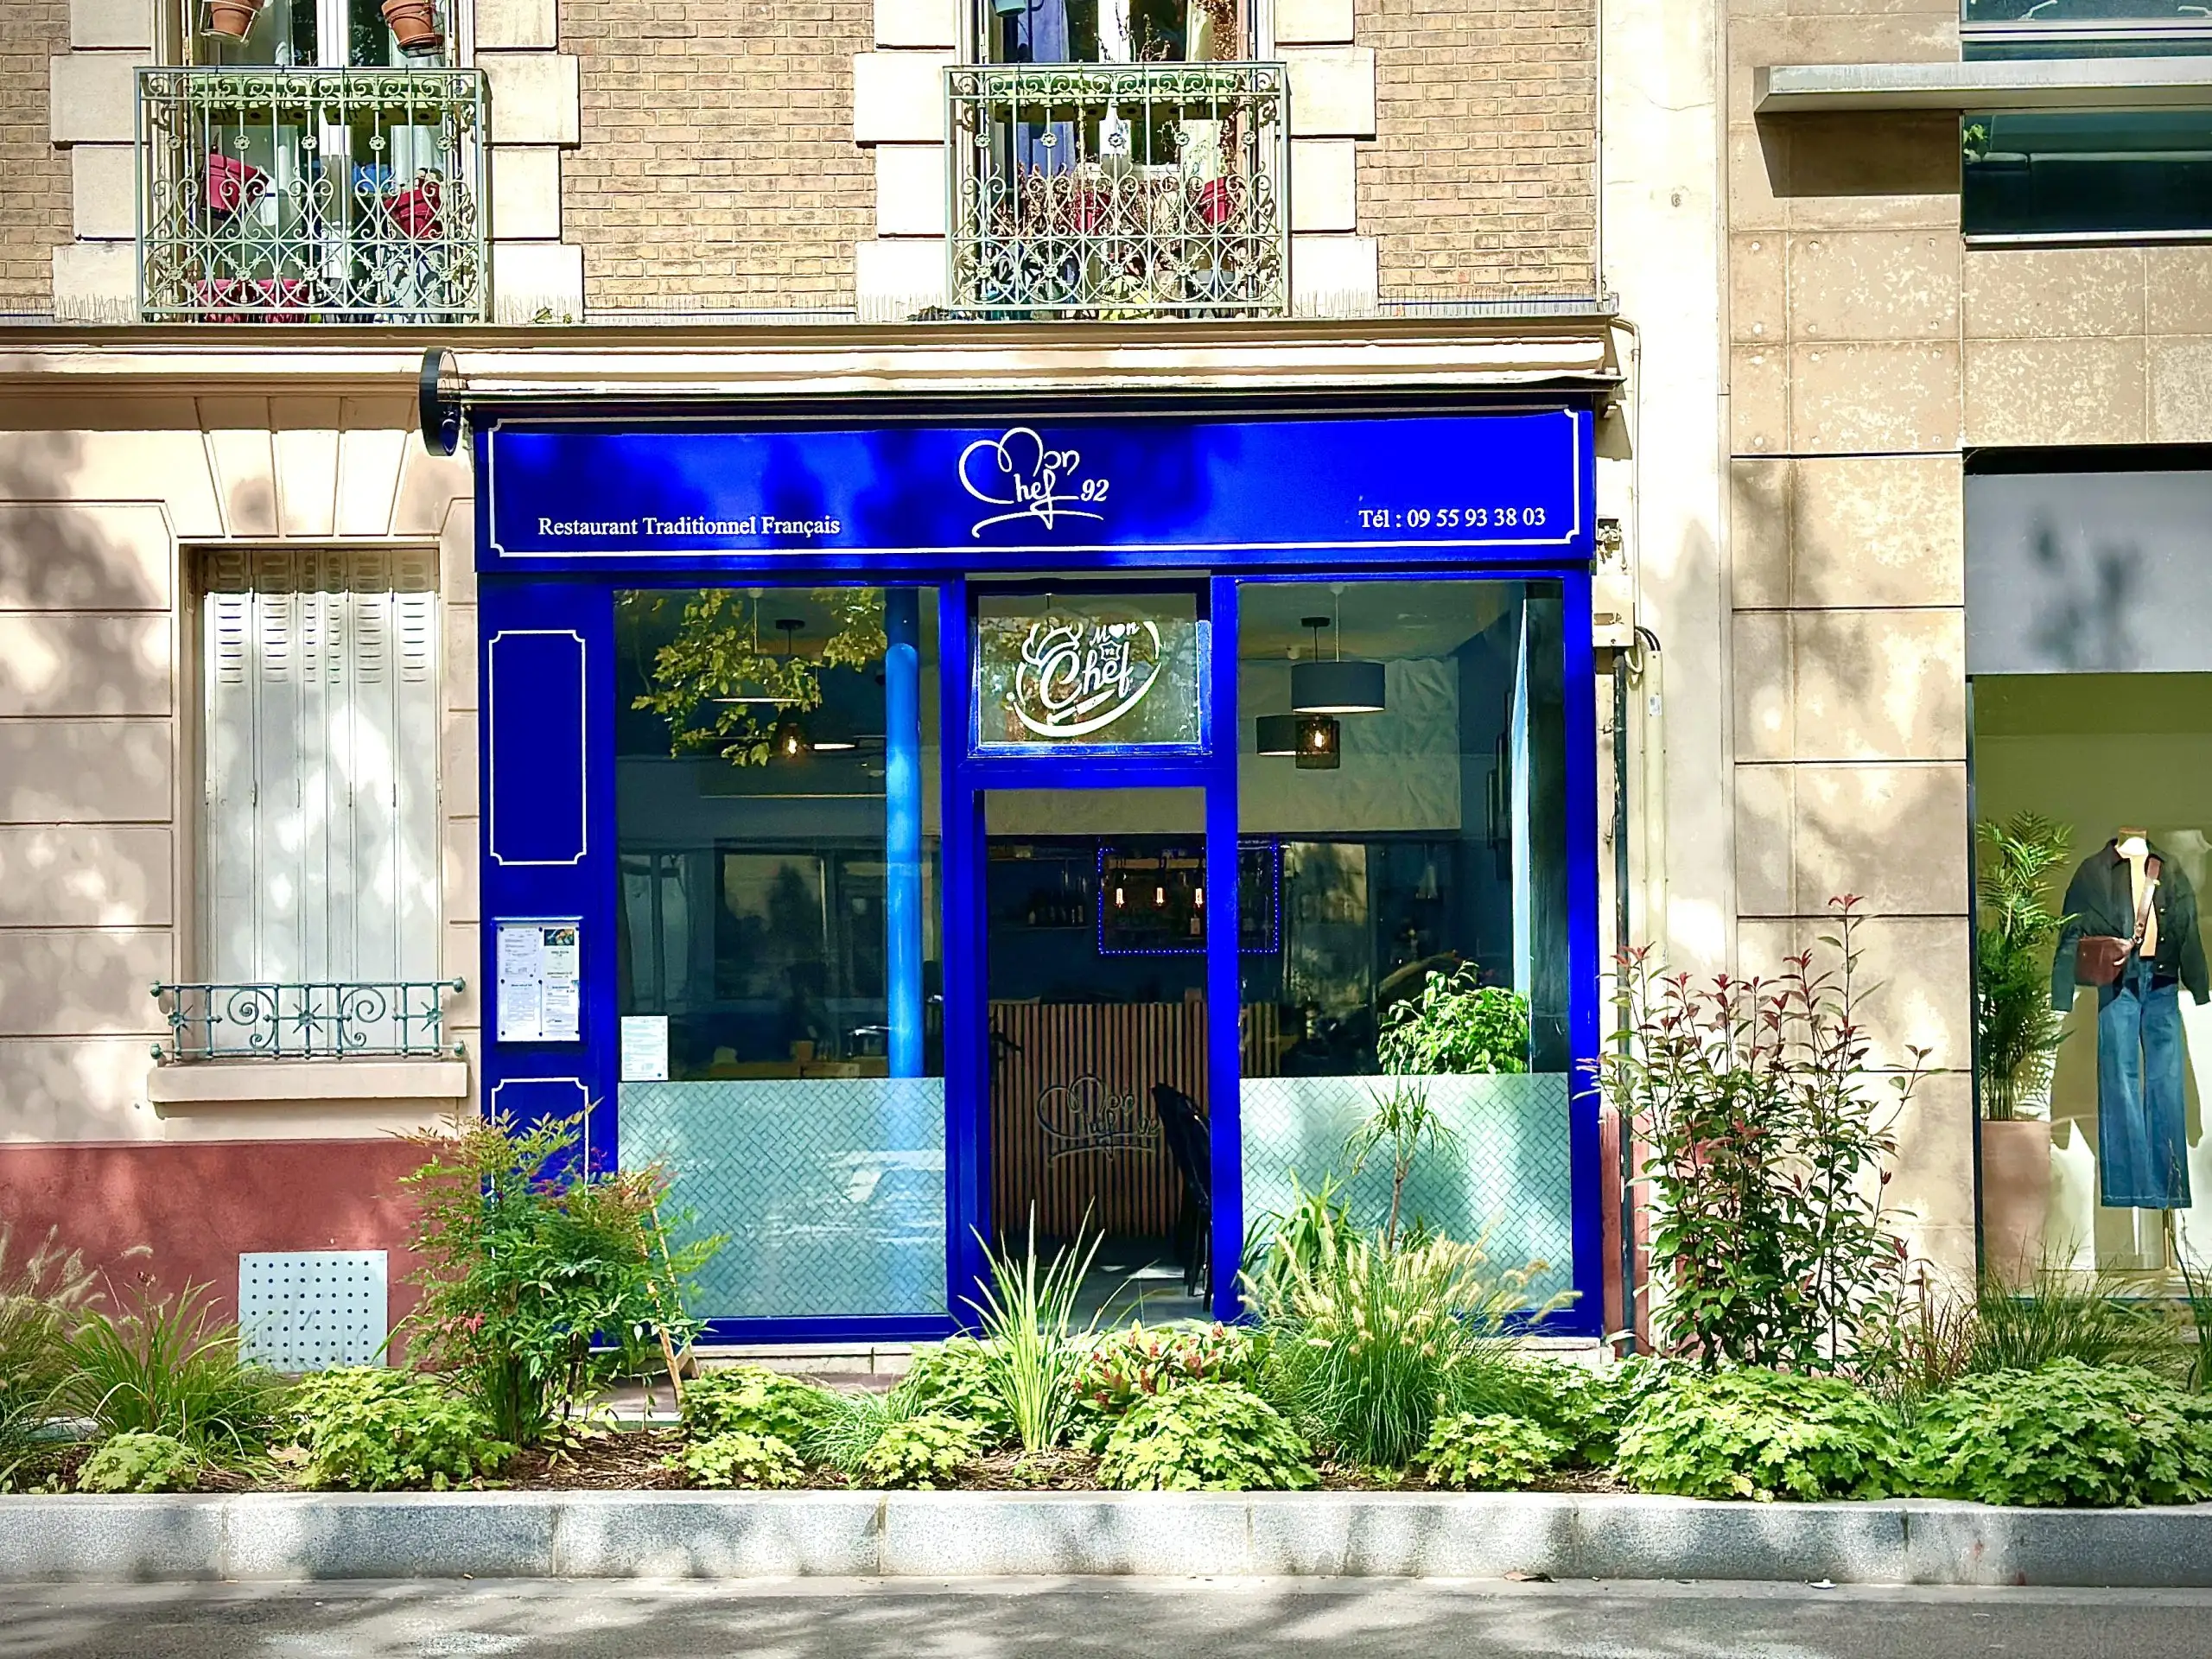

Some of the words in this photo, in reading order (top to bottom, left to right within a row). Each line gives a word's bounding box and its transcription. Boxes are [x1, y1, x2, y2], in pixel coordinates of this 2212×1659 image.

[997, 427, 1080, 477] Mon
[958, 439, 1080, 531] Chef
[1080, 479, 1109, 502] 92
[537, 518, 639, 536] Restaurant
[642, 516, 757, 535] Traditionnel
[760, 516, 841, 538] Français
[1357, 509, 1390, 528] Tél
[1407, 509, 1431, 528] 09
[1436, 509, 1460, 527] 55
[1465, 508, 1488, 527] 93
[1494, 507, 1517, 526] 38
[1522, 507, 1546, 526] 03
[1039, 641, 1135, 710] Chef
